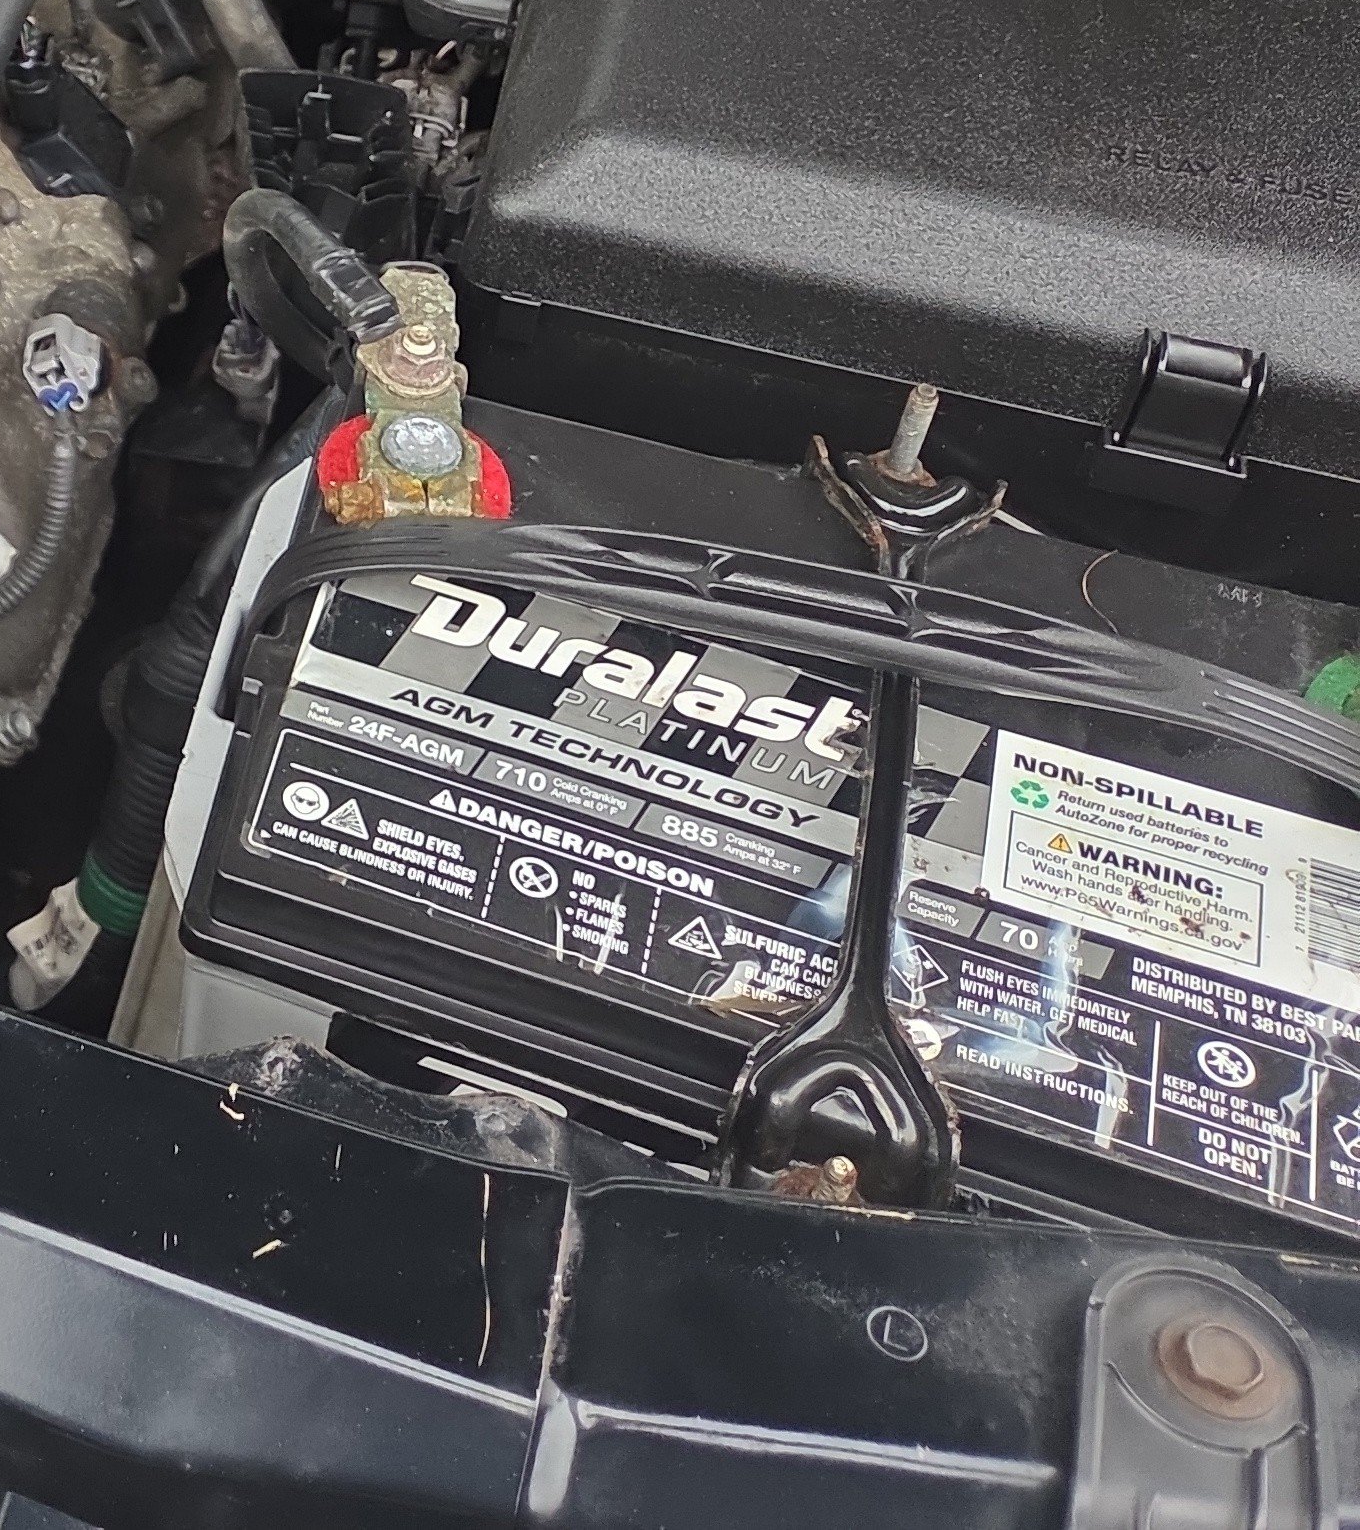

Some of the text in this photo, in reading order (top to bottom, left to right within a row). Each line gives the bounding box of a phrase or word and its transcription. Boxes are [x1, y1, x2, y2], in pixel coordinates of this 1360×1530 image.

[410, 573, 861, 762] Duralast
[307, 710, 344, 728] Number
[309, 701, 330, 715] Part
[347, 716, 465, 768] 24F-AGM
[390, 688, 821, 828] AGM TECHNOLOGY
[553, 687, 841, 790] PLATINUM
[495, 760, 547, 792] 710
[552, 777, 628, 811] Cold Cranking
[1013, 752, 1264, 839] NON-SPILLABLE
[549, 787, 581, 806] Amps
[582, 797, 594, 809] at
[609, 806, 619, 816] F
[1057, 789, 1229, 848] Return used batteries to
[376, 819, 425, 847] SHIELD
[458, 796, 715, 898] DANGER/POISON
[661, 814, 719, 848] 885
[725, 832, 776, 858] Cranking
[1055, 803, 1269, 876] AutoZone for proper recycling
[272, 821, 475, 901] CAN CAUSE BLINDNESS OR INJURY.
[372, 836, 478, 884] EXPLOSIVE GASES
[572, 869, 596, 890] NO
[722, 844, 756, 864] Amps
[757, 854, 770, 866] at
[792, 865, 802, 875] F
[1015, 841, 1253, 923] Cancer and Reproductive Harm.
[1077, 840, 1224, 899] WARNING:
[579, 891, 627, 919] SPARKS
[907, 903, 960, 927] Capacity
[908, 891, 957, 914] Reserve
[1020, 874, 1243, 952] www.P65Warnings.ca.gov
[1032, 859, 1073, 883] Wash
[1076, 873, 1124, 897] hands
[1164, 898, 1234, 933] handling.
[1294, 903, 1306, 934] 21112
[571, 923, 630, 956] SMOKING
[575, 906, 625, 935] FLAMES
[1000, 921, 1039, 950] 70
[724, 925, 839, 977] SULFURIC ACI
[770, 958, 832, 988] CAN CAU
[956, 996, 991, 1017] HELP
[959, 976, 1138, 1047] WITH WATER. GET MEDICAL
[961, 959, 1131, 1025] FLUSH EYES IMMEDIATELY
[1131, 975, 1307, 1044] MEMPHIS, TN 38103
[1132, 956, 1248, 1007] DISTRIBUTED
[1251, 993, 1277, 1014] BY
[1280, 1002, 1328, 1032] BEST
[956, 1043, 1134, 1115] READ INSTRUCTIONS.
[1163, 1073, 1280, 1123] KEEP OUT OF THE
[1162, 1087, 1305, 1146] REACH OF CHILDREN.
[1198, 1126, 1273, 1165] DO NOT
[1203, 1147, 1263, 1181] OPEN.
